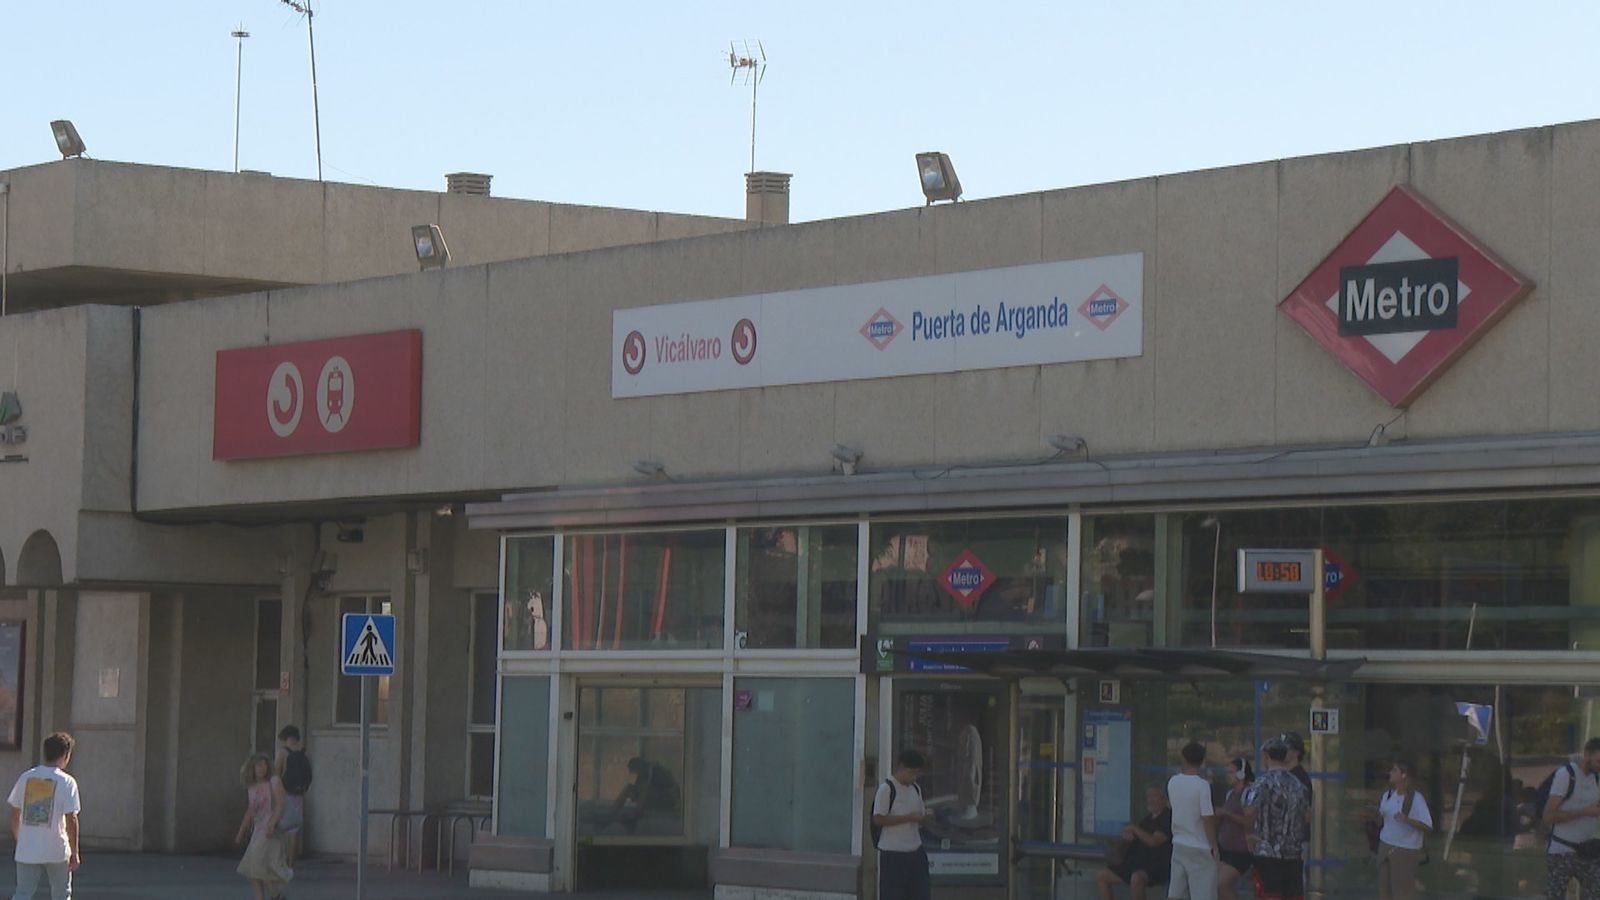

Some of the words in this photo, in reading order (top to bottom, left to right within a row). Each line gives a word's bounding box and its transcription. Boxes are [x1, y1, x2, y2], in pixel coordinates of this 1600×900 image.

[1090, 302, 1115, 314] Metro
[1346, 277, 1450, 322] Metro
[871, 324, 892, 335] Metro
[912, 309, 965, 341] Puerta
[970, 304, 991, 335] de
[996, 296, 1068, 339] Arganda
[655, 332, 722, 363] Vicálvaro
[952, 571, 980, 586] Metro
